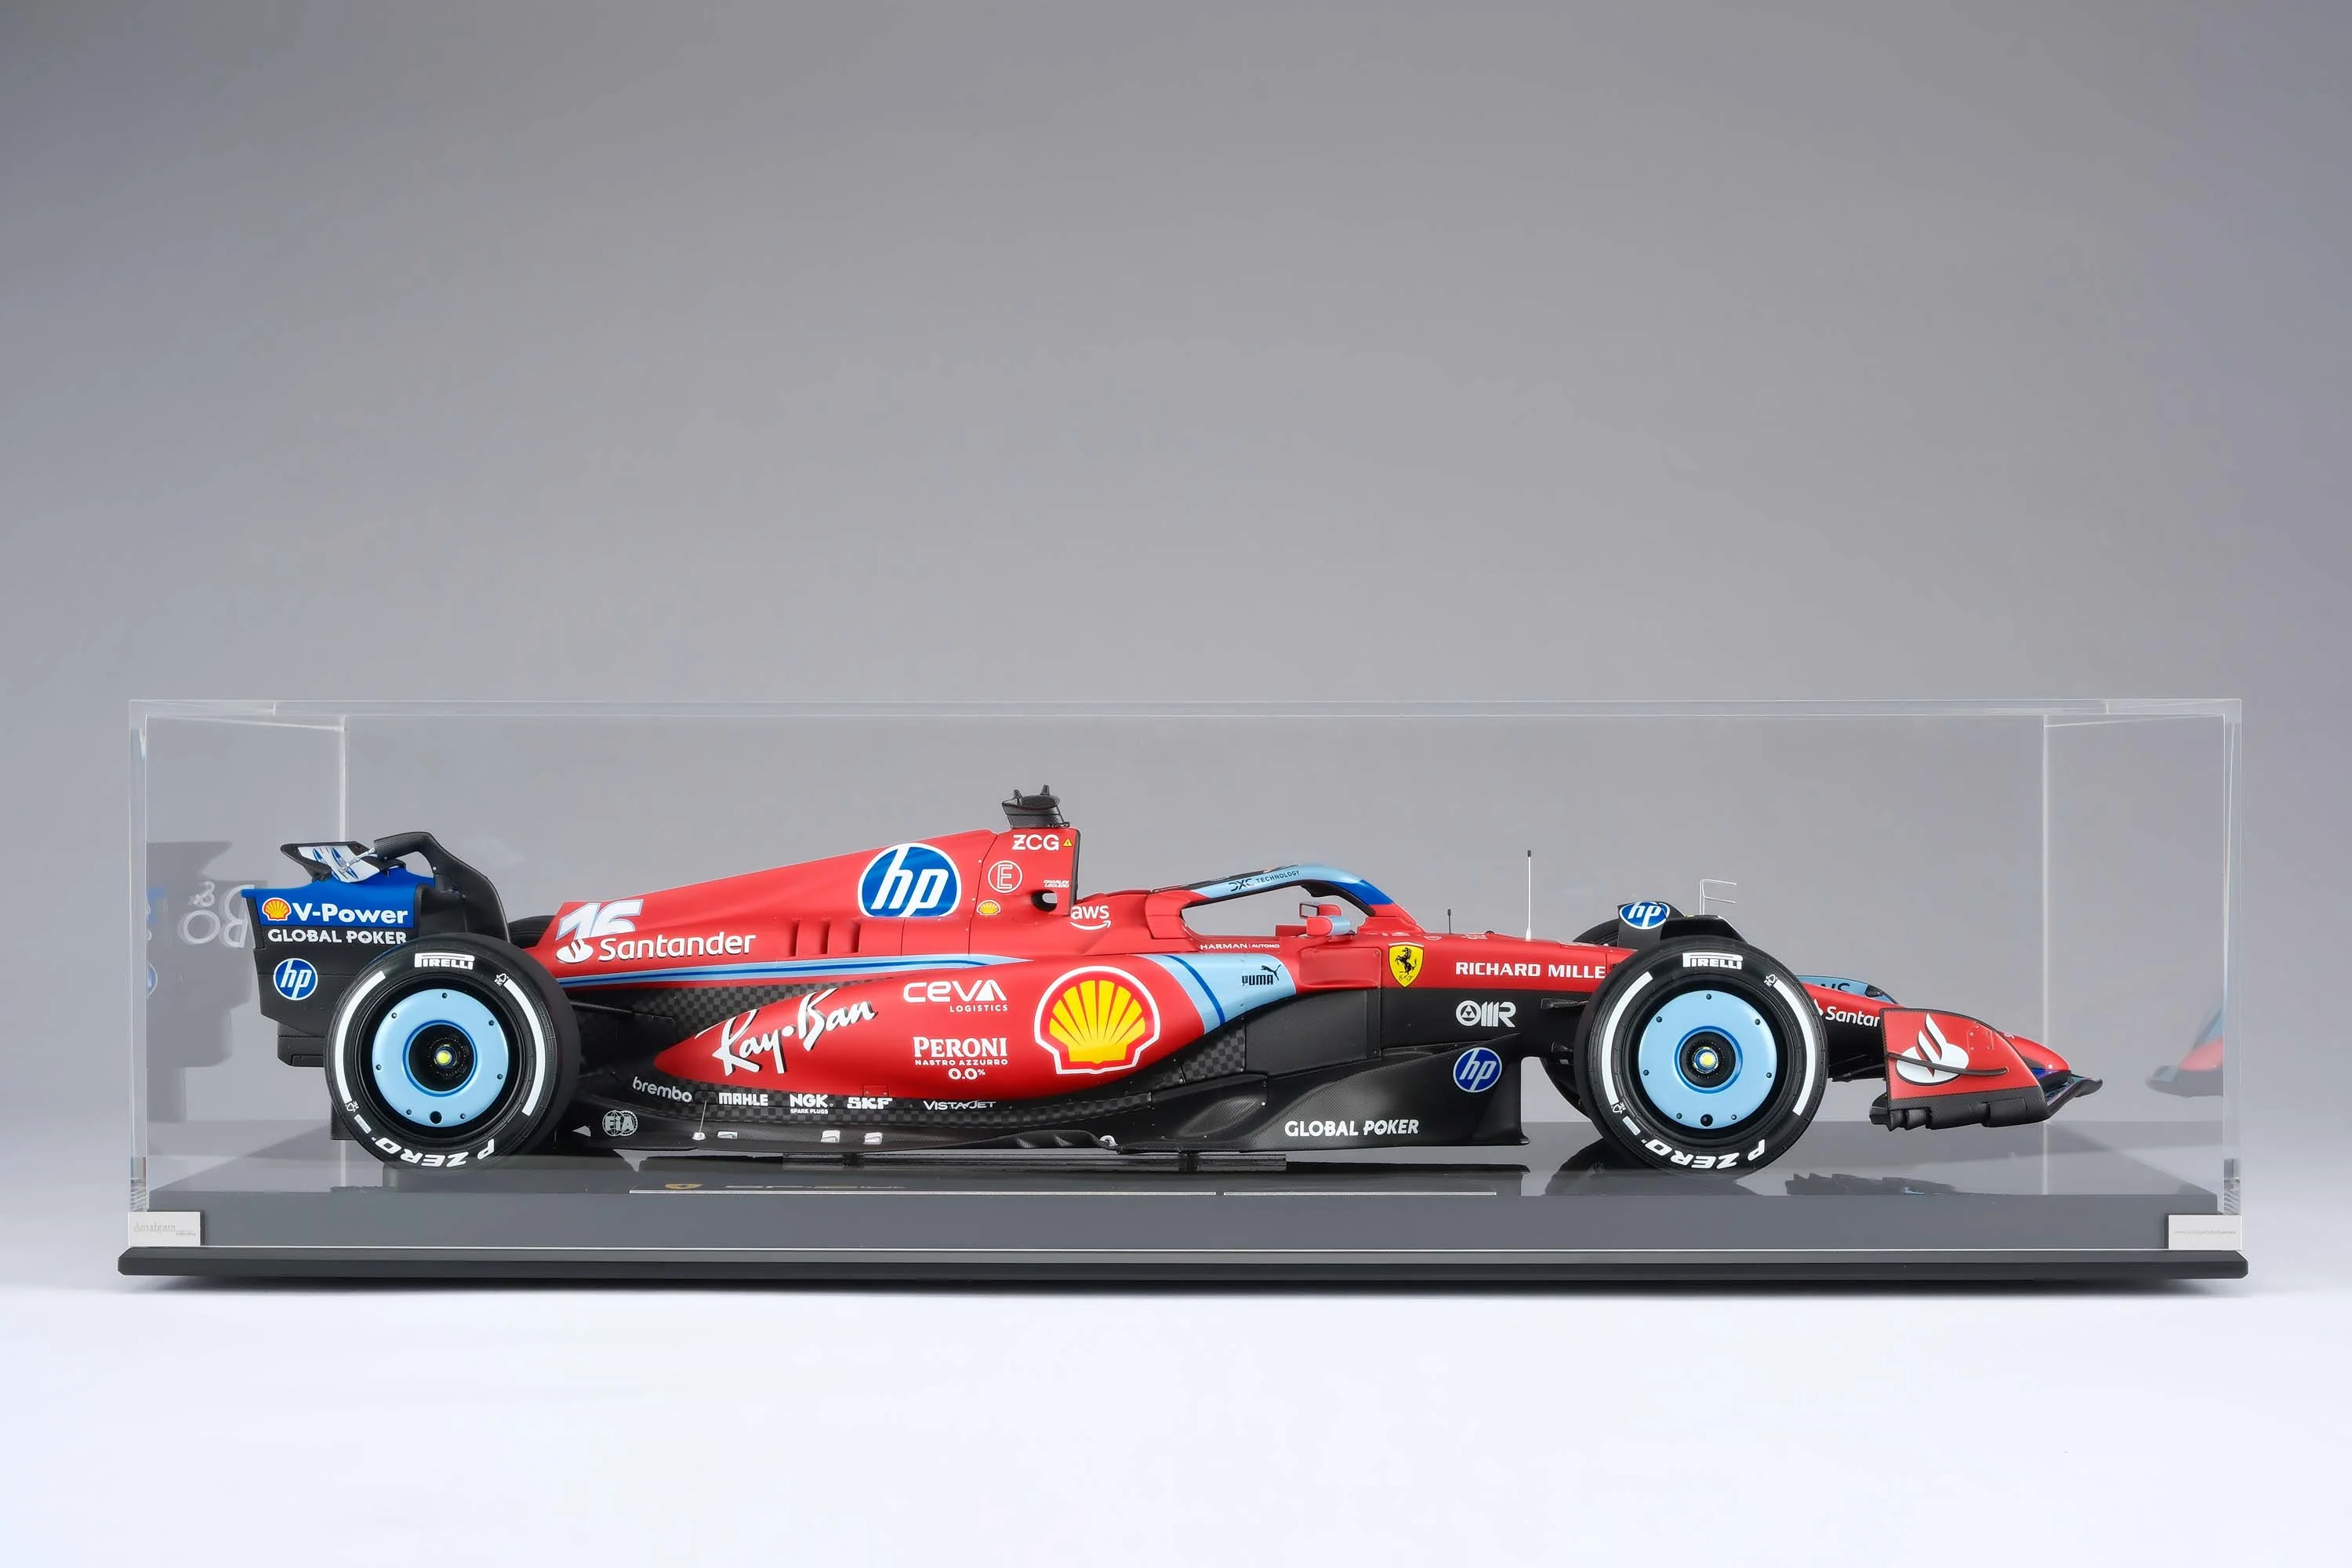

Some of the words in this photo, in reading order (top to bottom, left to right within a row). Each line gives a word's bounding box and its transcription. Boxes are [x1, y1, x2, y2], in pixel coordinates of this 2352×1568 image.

[1012, 834, 1059, 851] ZCG
[870, 841, 949, 917] hp
[1256, 870, 1300, 884] TECHNOLOGY
[292, 902, 408, 924] V-Power
[1071, 904, 1110, 920] aws
[1627, 902, 1662, 929] hp
[267, 929, 343, 943] GLOBAL
[346, 930, 408, 945] POKER
[598, 931, 757, 962] Santander
[414, 952, 475, 971] PIRELLI
[1455, 961, 1541, 977] RICHARD
[1548, 964, 1606, 979] MILLE
[1682, 952, 1743, 971] PIRELLI
[280, 958, 312, 1000] hp
[1241, 975, 1274, 986] PUMA
[949, 1004, 1008, 1013] LOGISTICS
[913, 1036, 1008, 1058] PERONI
[1458, 1048, 1496, 1091] hp
[632, 1076, 692, 1103] brembo
[718, 1092, 769, 1106] MAHLE
[789, 1093, 829, 1108] NGK
[847, 1096, 893, 1110] SKF
[1284, 1120, 1359, 1137] GLOBAL
[1363, 1119, 1420, 1135] POKER
